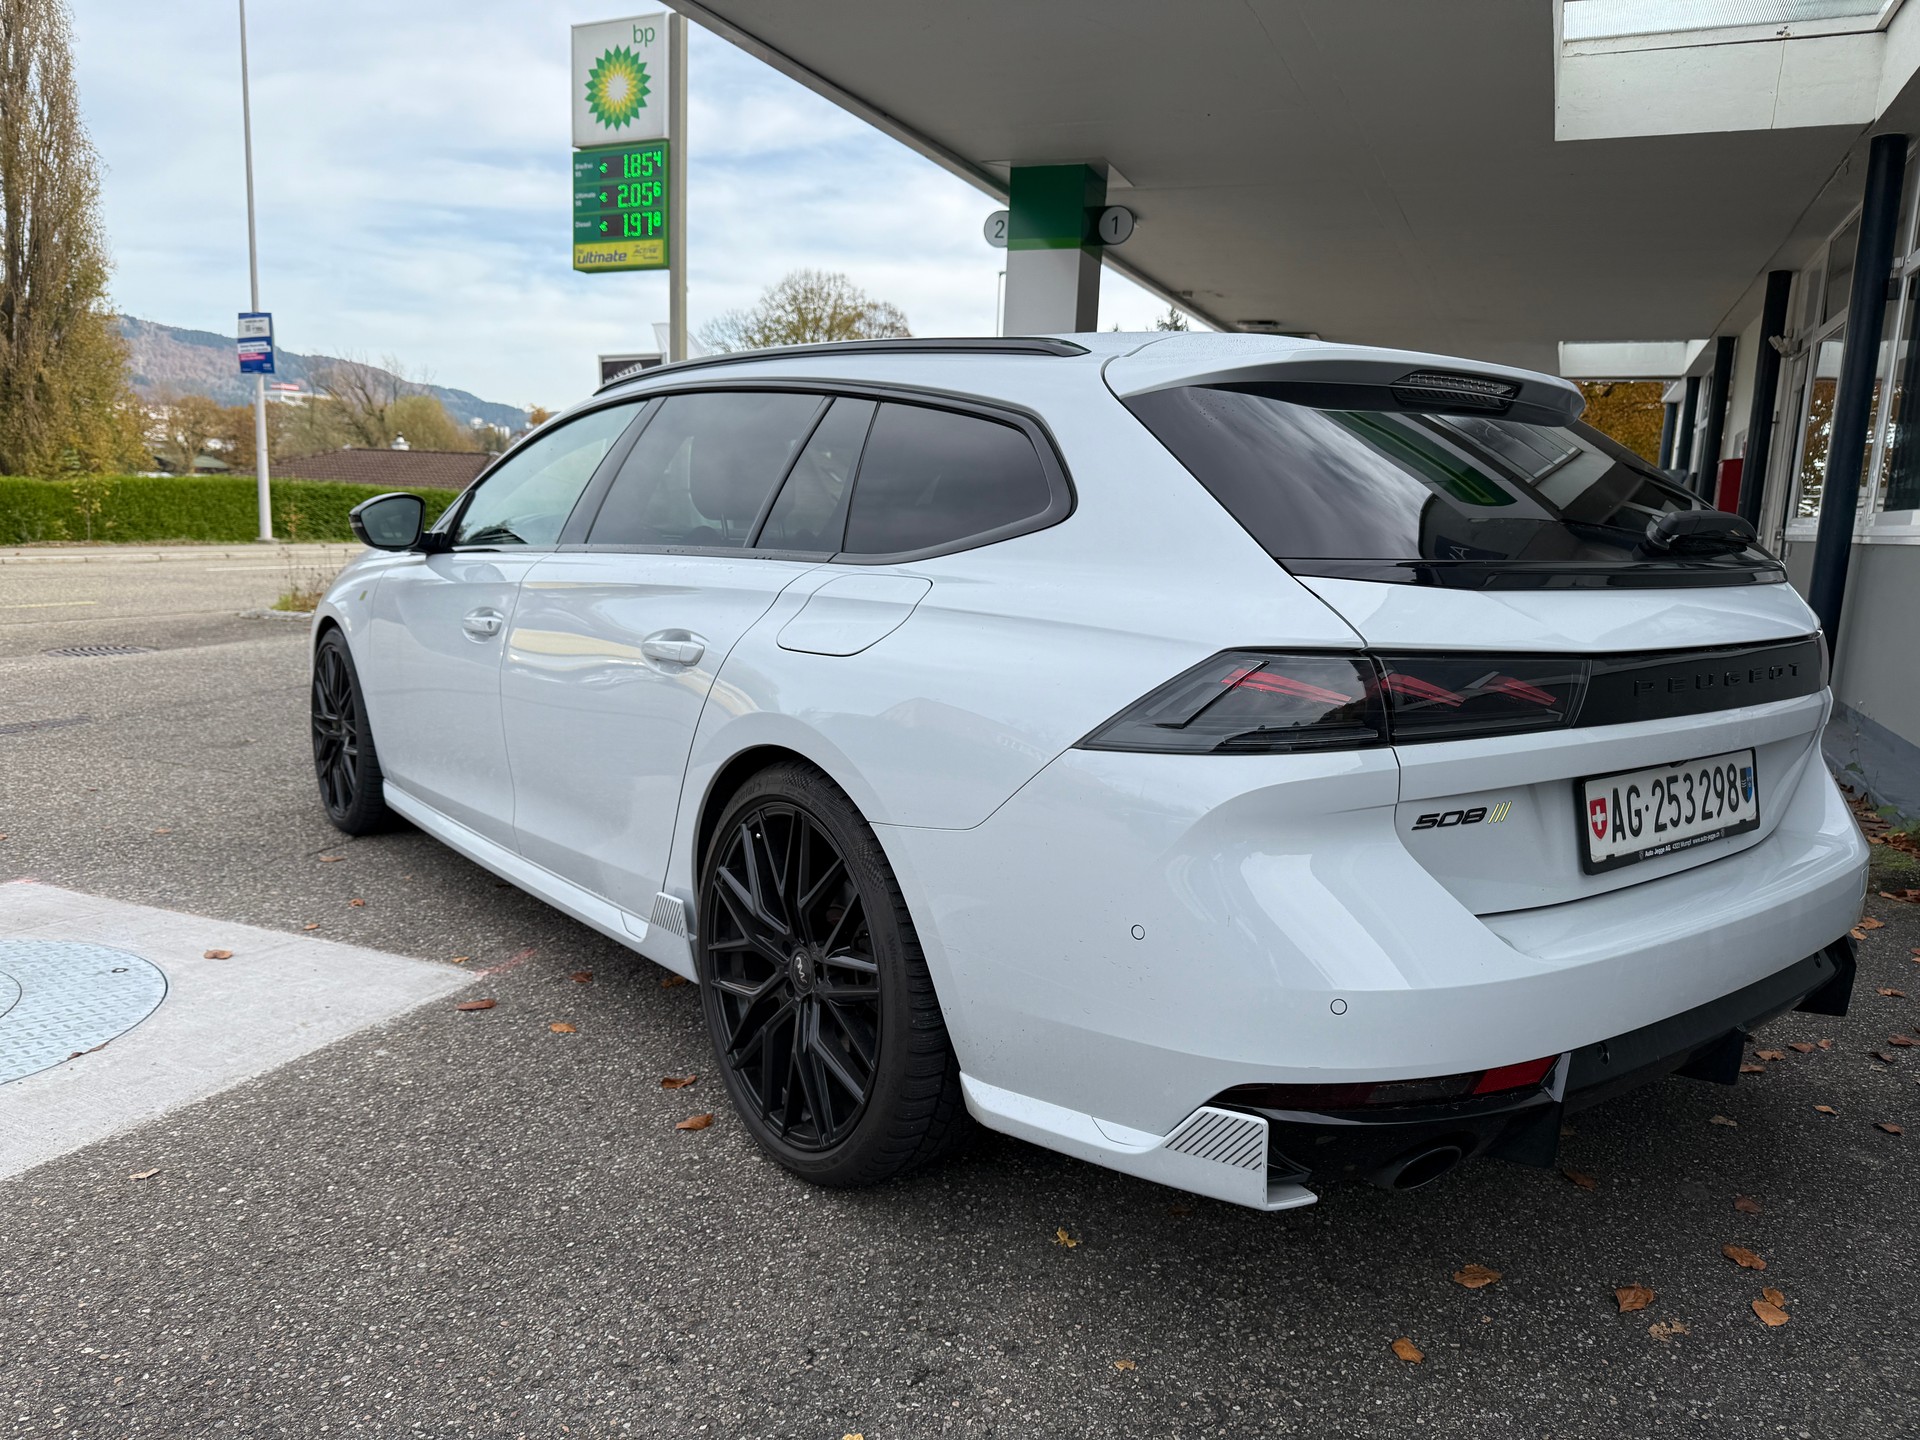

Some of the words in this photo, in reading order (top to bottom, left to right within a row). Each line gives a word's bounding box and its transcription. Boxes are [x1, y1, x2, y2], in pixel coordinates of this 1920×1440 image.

[633, 24, 655, 47] bp
[994, 220, 1005, 238] 2
[1111, 215, 1119, 235] 1
[577, 249, 627, 264] ultimate
[1633, 661, 1801, 697] PEUGEOT
